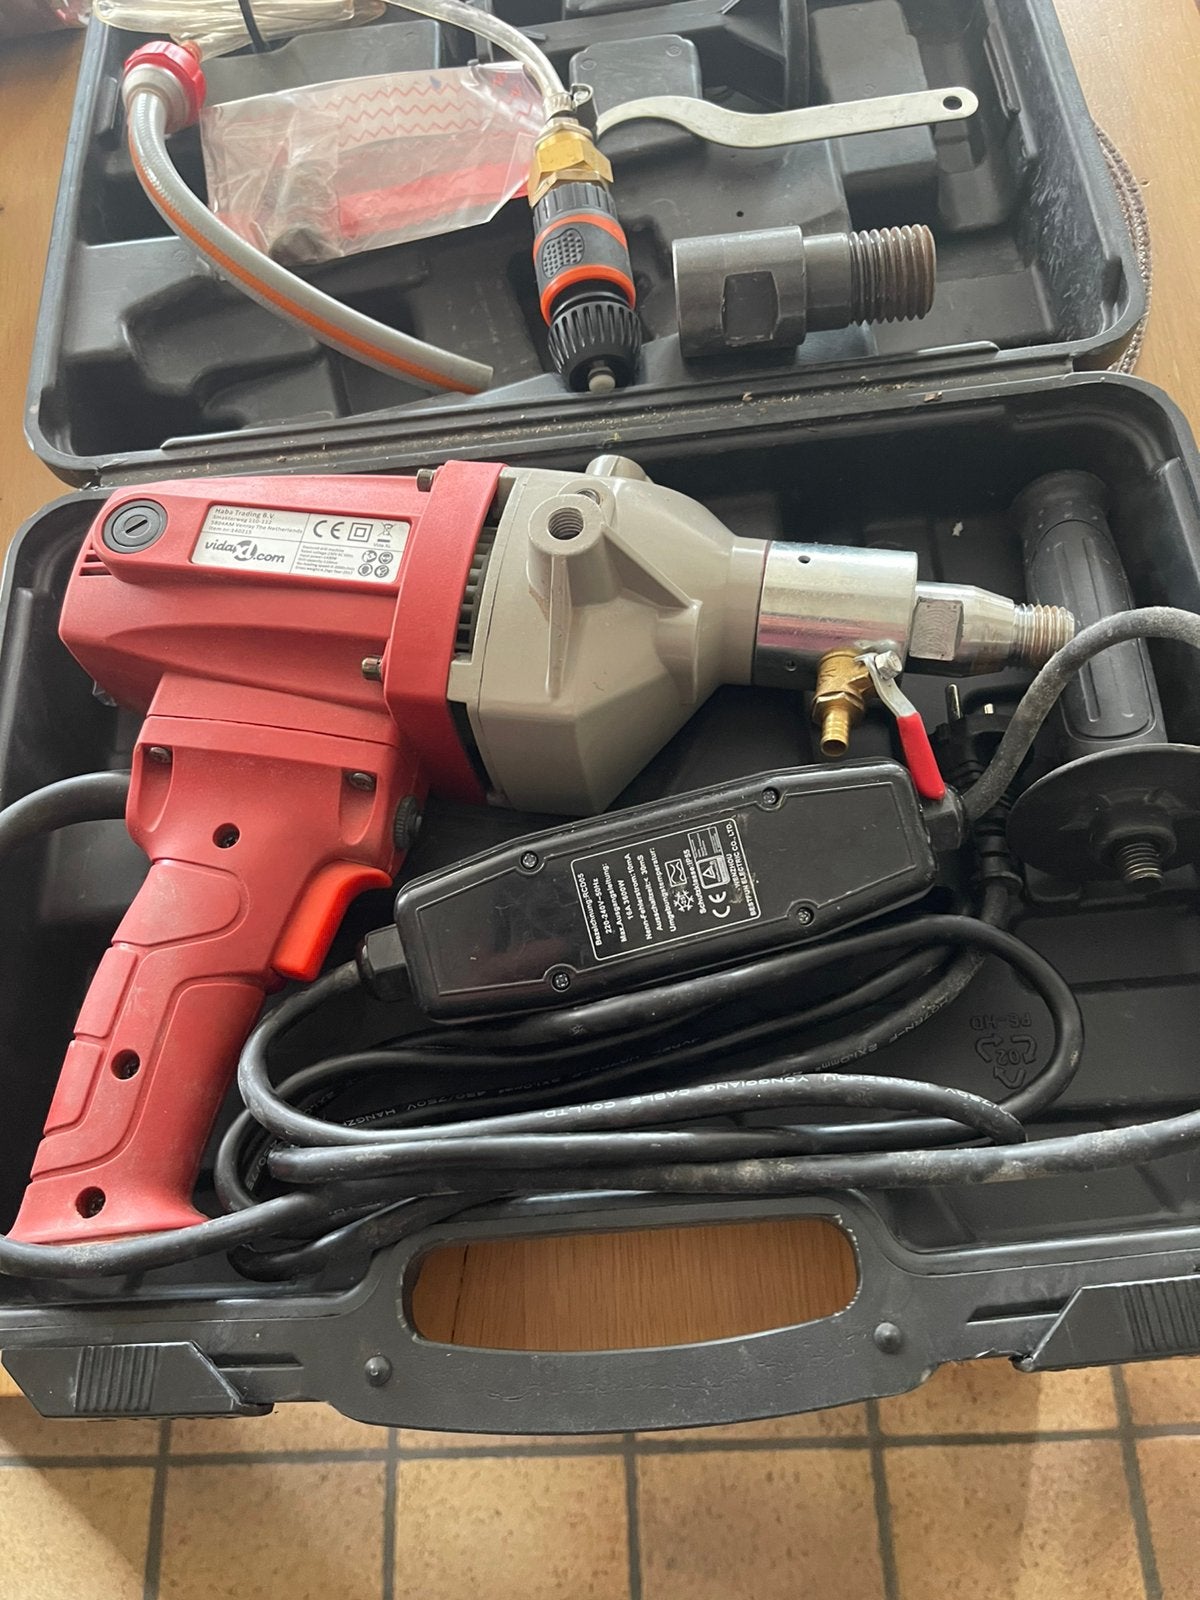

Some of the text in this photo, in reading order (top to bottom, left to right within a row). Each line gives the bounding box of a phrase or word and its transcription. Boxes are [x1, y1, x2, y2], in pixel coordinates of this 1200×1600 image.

[235, 510, 261, 518] Trading
[733, 852, 747, 883] ELECTRIC
[708, 892, 731, 918] CE
[630, 1088, 691, 1105] CABLE
